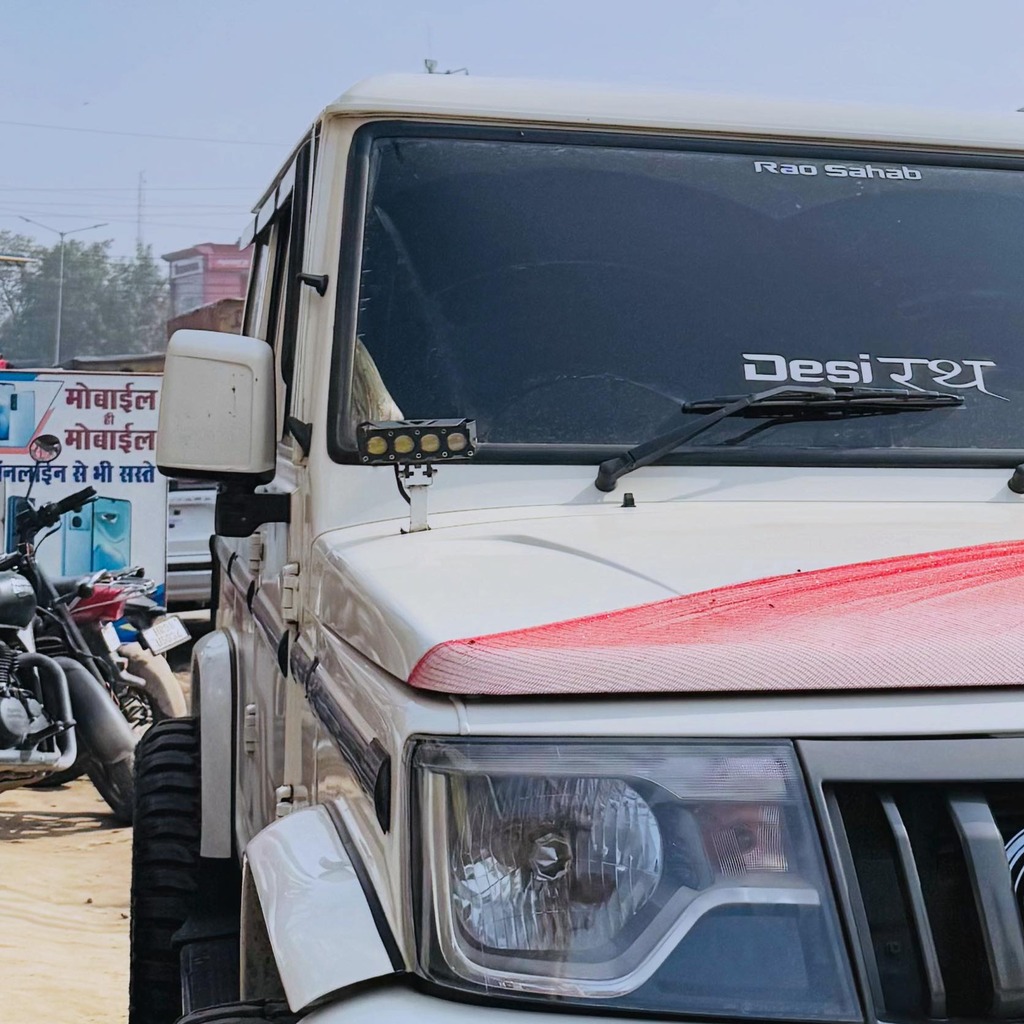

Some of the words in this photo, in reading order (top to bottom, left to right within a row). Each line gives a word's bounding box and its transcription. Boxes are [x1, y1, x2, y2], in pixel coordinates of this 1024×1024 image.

[753, 161, 818, 176] Rao
[824, 164, 922, 180] Sahab
[742, 353, 874, 384] Desi
[876, 357, 1010, 401] रथ
[65, 382, 158, 412] मोबाईल
[104, 412, 114, 425] ही
[64, 423, 157, 453] मोबाईल
[72, 460, 89, 483] से
[93, 461, 113, 483] भी
[119, 460, 156, 484] सस्ते
